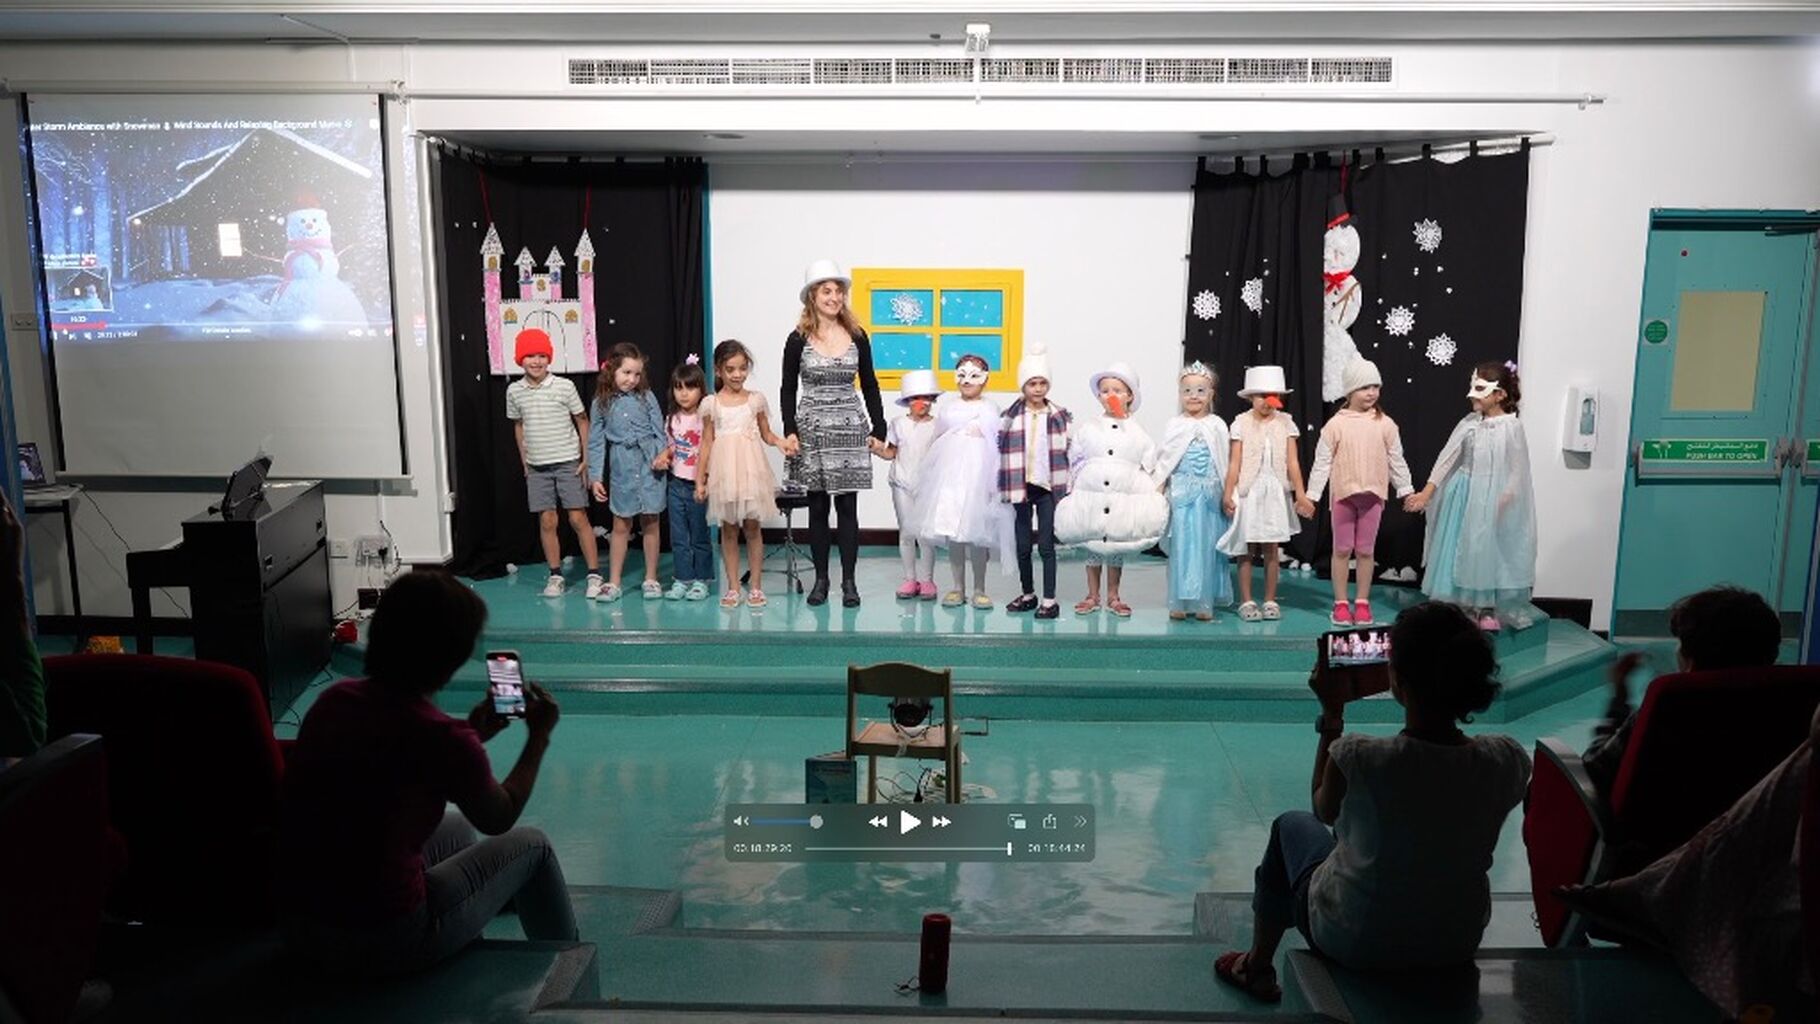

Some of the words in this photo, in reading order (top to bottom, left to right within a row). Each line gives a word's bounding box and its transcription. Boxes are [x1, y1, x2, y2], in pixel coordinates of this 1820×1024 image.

[43, 122, 67, 131] Storm
[173, 121, 193, 130] Wind
[193, 120, 222, 129] Sounds
[223, 120, 239, 129] And
[239, 120, 273, 131] Relaxing
[273, 119, 317, 131] Background
[1725, 452, 1736, 460] TO
[1736, 452, 1758, 460] OPEN
